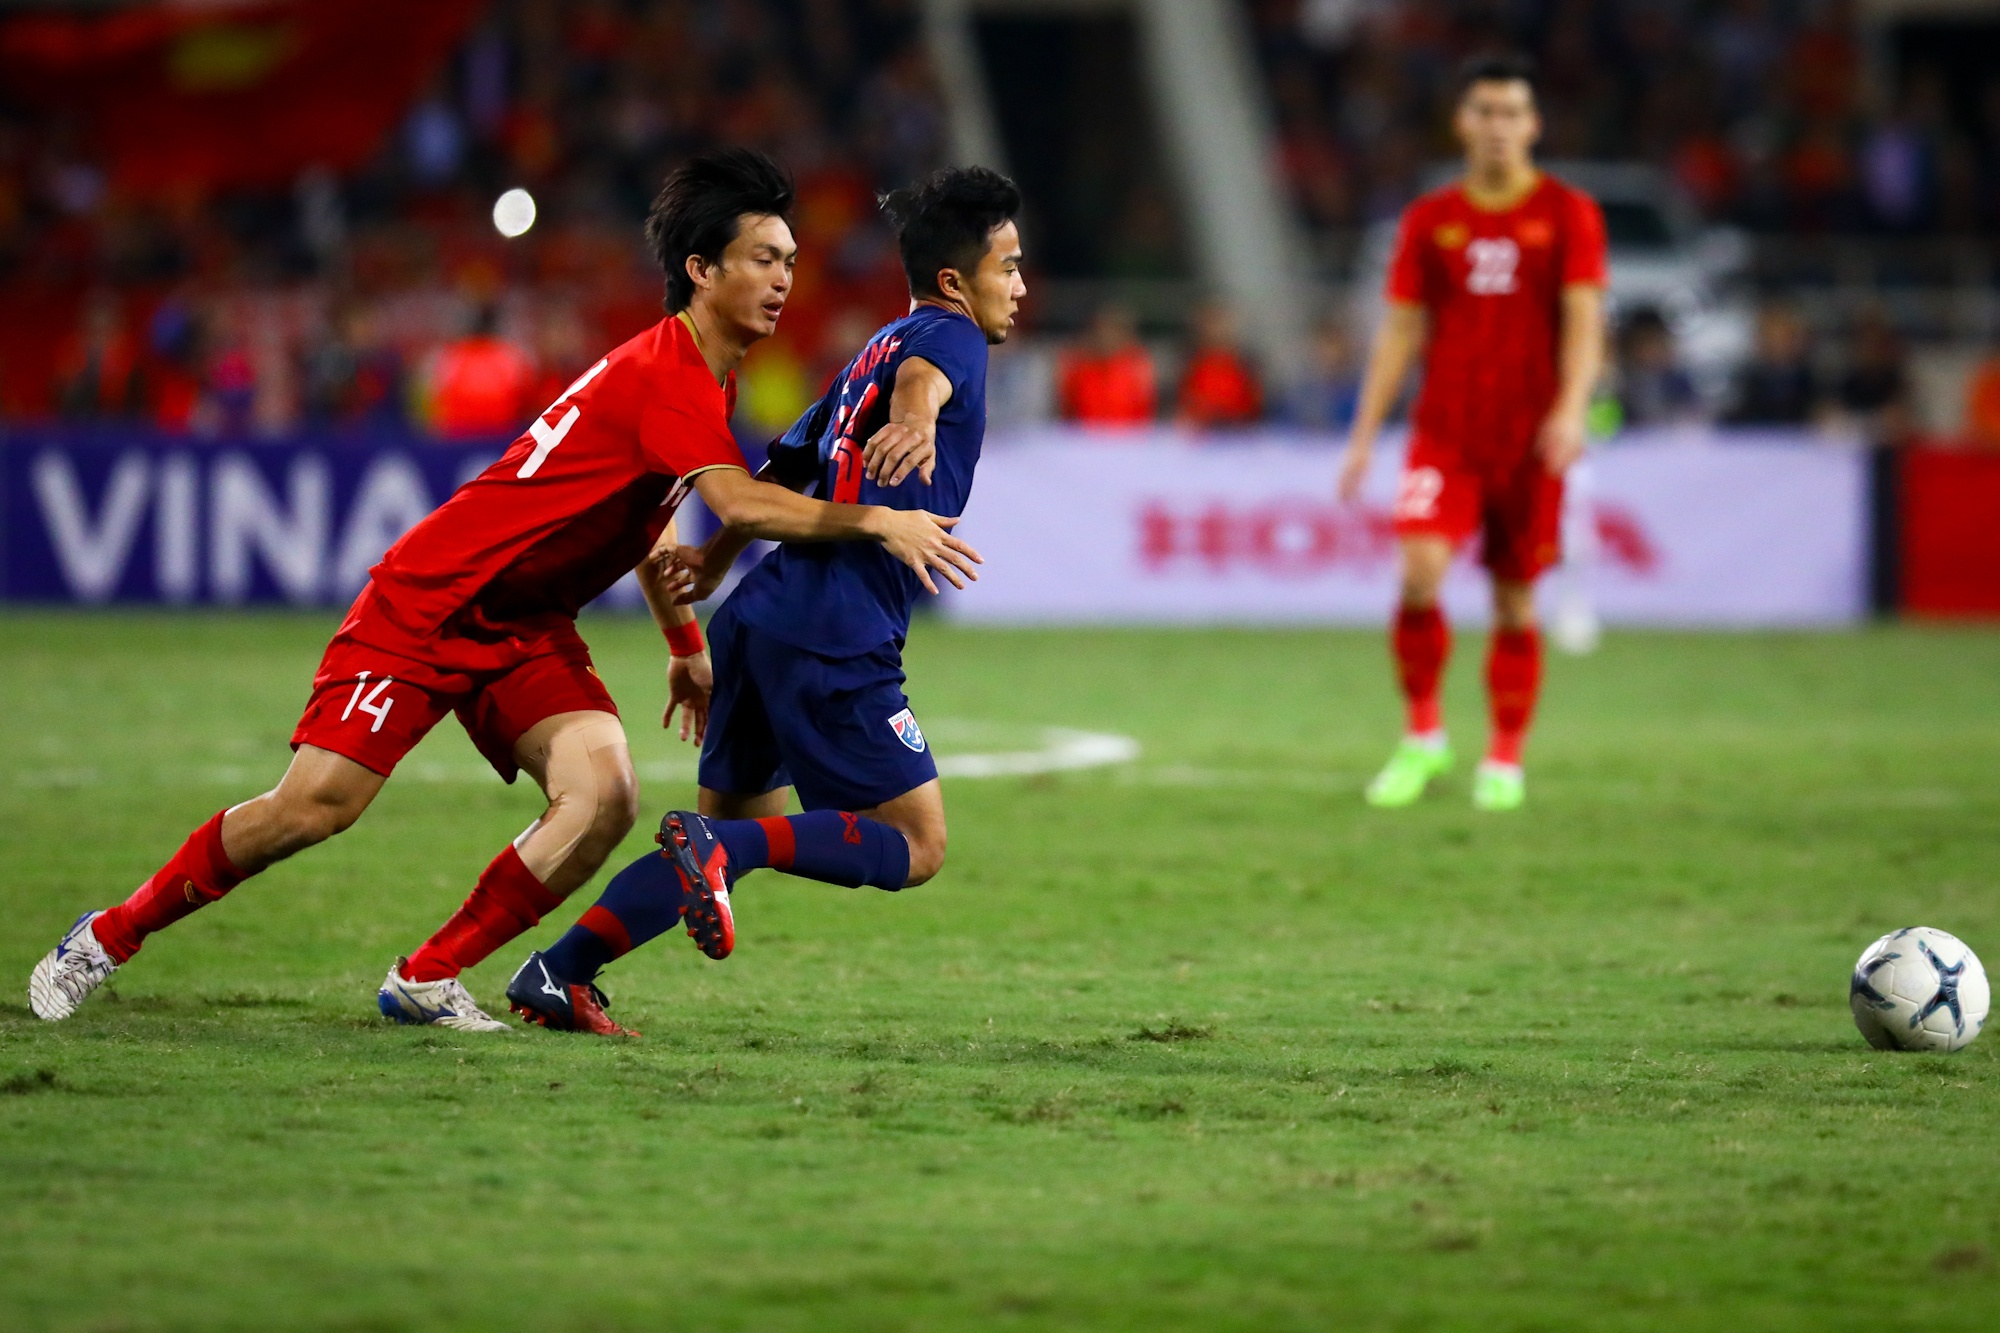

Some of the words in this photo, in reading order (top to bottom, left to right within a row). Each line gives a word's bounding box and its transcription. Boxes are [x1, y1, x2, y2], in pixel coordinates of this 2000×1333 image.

[1465, 238, 1520, 295] 22
[31, 450, 490, 600] VINA
[1138, 500, 1660, 580] HOA
[341, 670, 395, 733] 14
